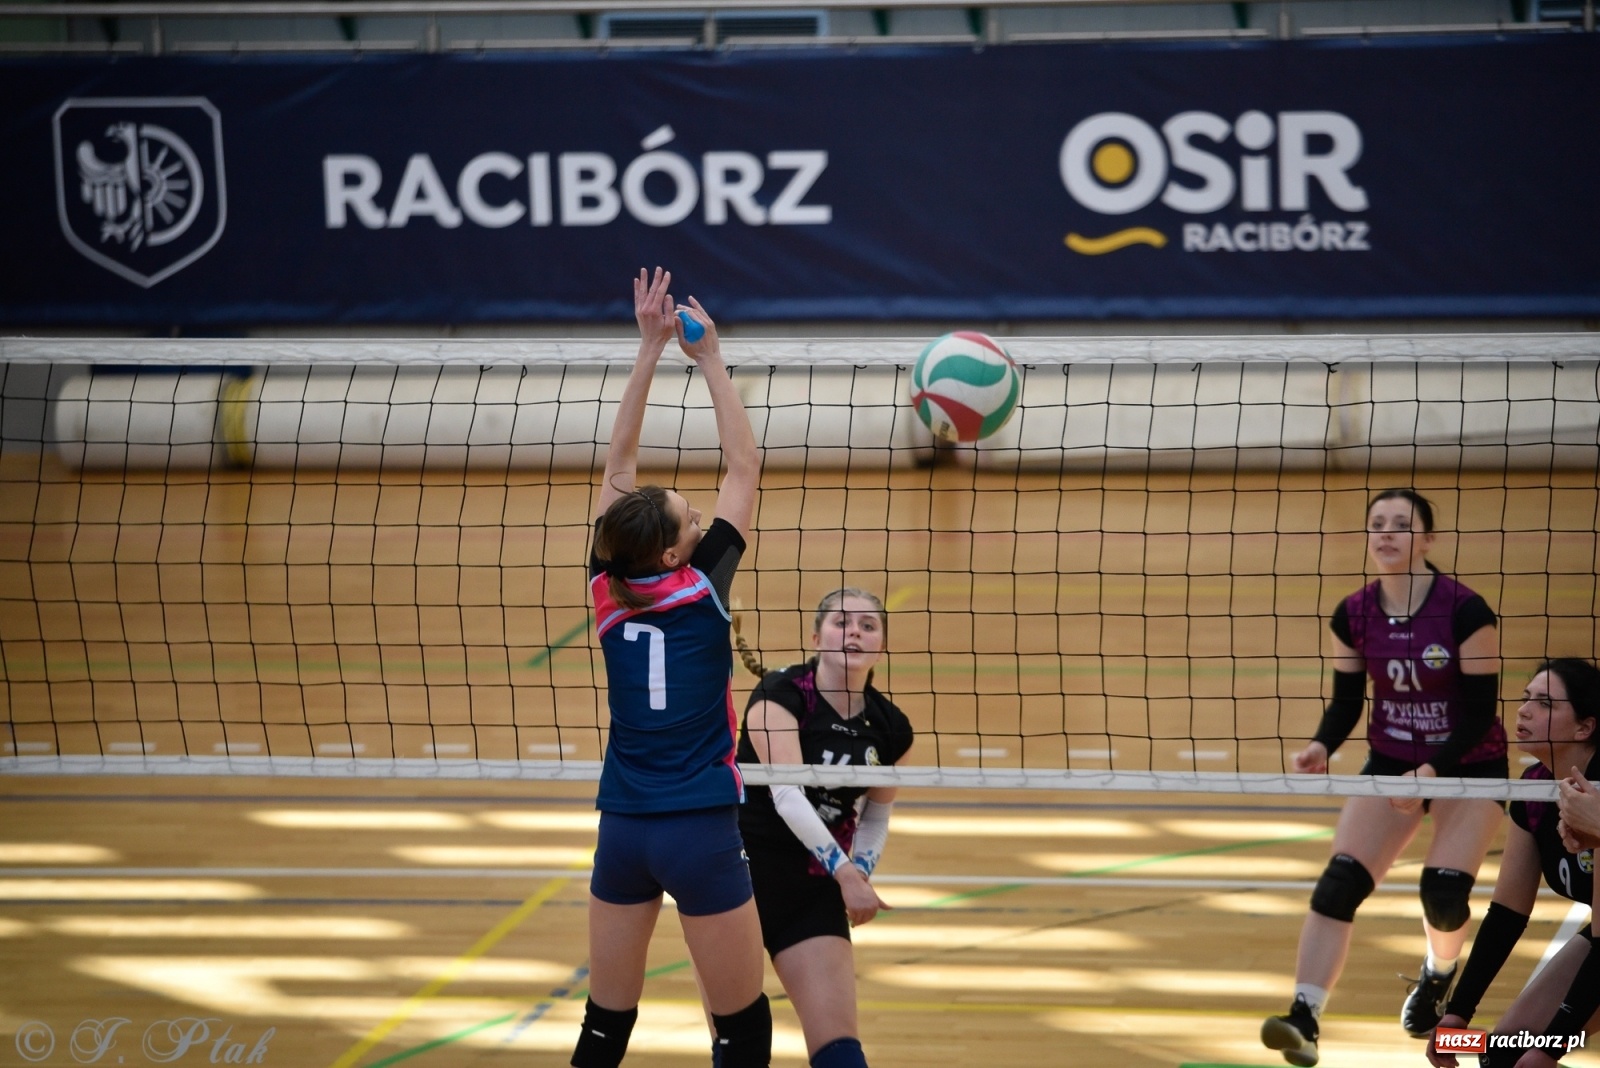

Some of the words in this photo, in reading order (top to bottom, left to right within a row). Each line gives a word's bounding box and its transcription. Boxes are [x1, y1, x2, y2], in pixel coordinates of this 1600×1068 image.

[324, 125, 832, 229] RACIBÓRZ
[1183, 214, 1370, 253] RACIBÓRZ
[623, 622, 667, 711] 7
[1386, 659, 1423, 692] 21
